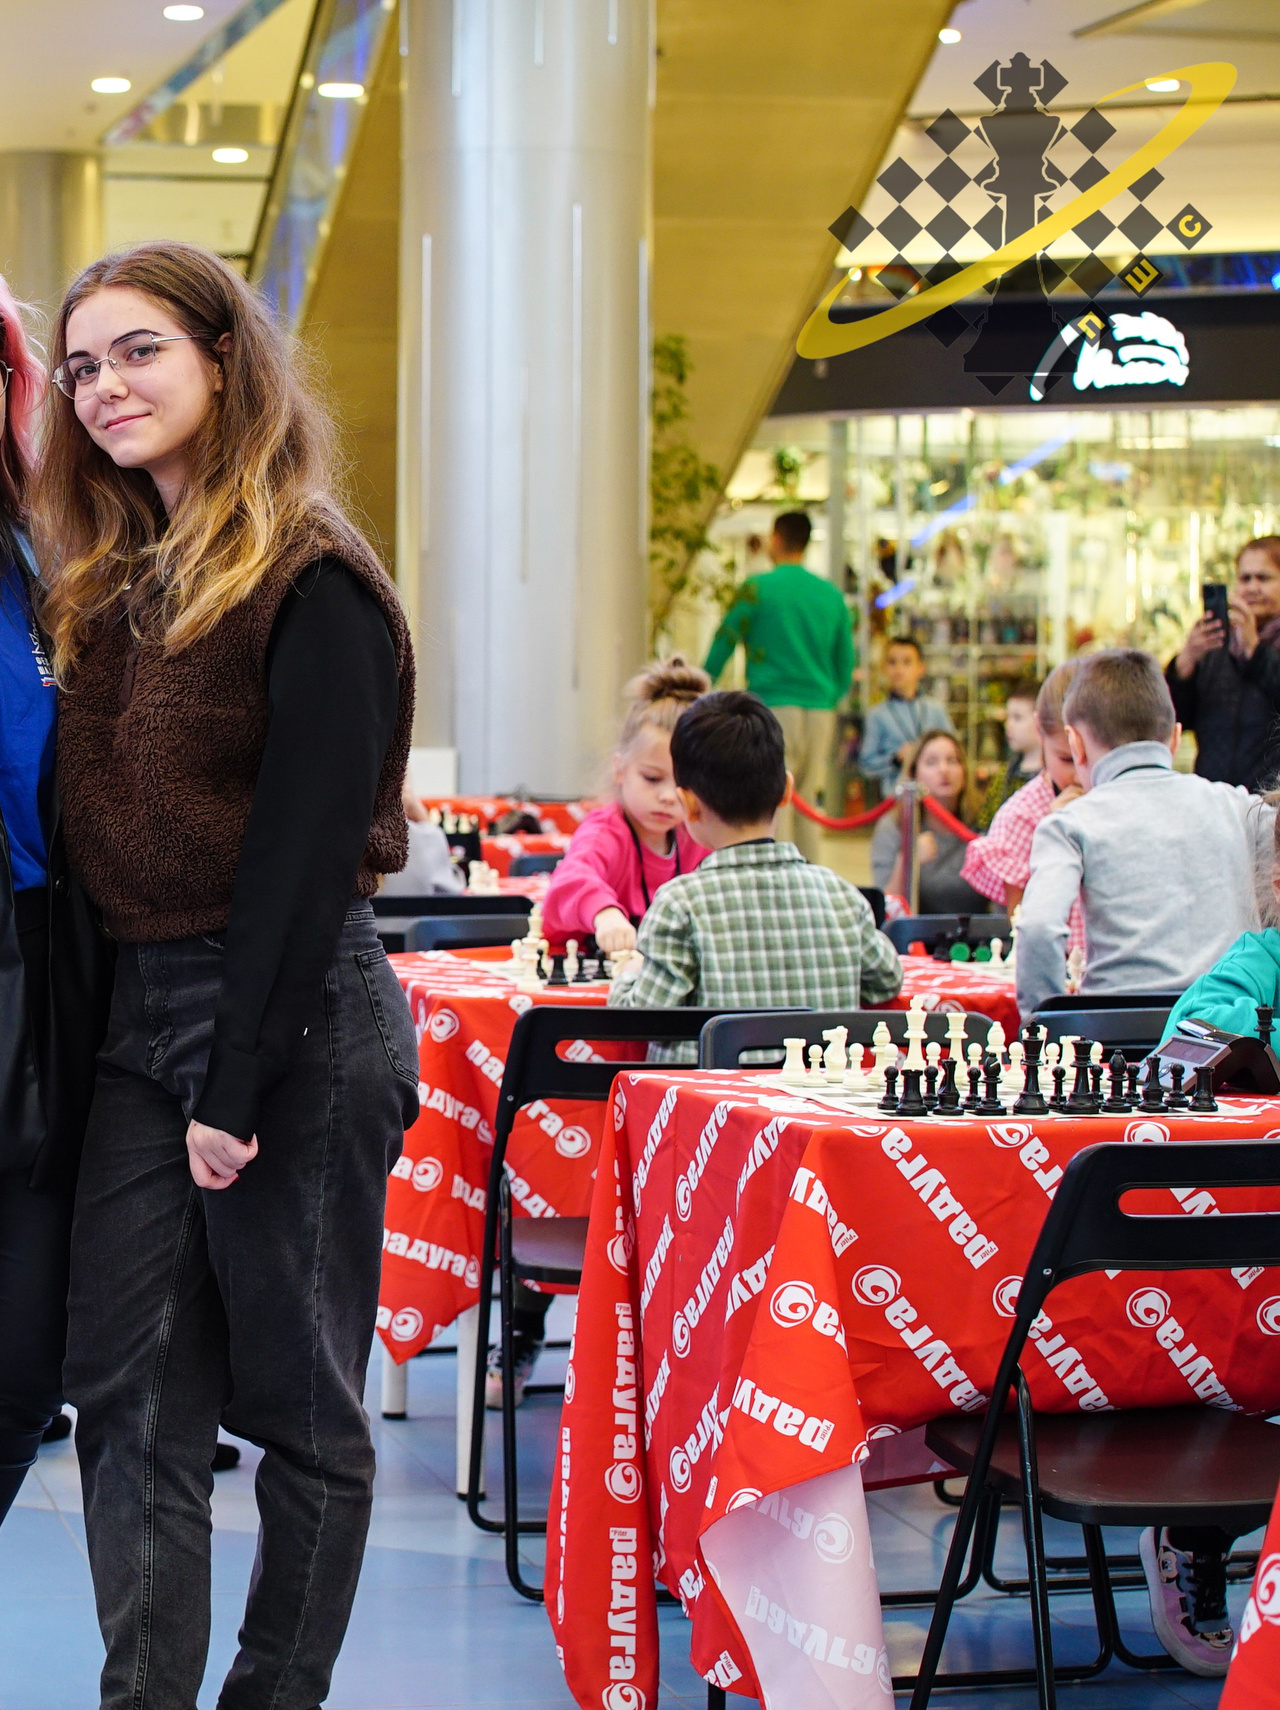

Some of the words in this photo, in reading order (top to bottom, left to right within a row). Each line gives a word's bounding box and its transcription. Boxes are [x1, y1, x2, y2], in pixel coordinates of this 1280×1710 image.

[881, 1127, 999, 1270] радуга
[683, 1215, 734, 1329] радуга
[612, 1302, 637, 1460] радуга
[1028, 1308, 1115, 1413] адуга
[607, 1526, 638, 1681] радуга
